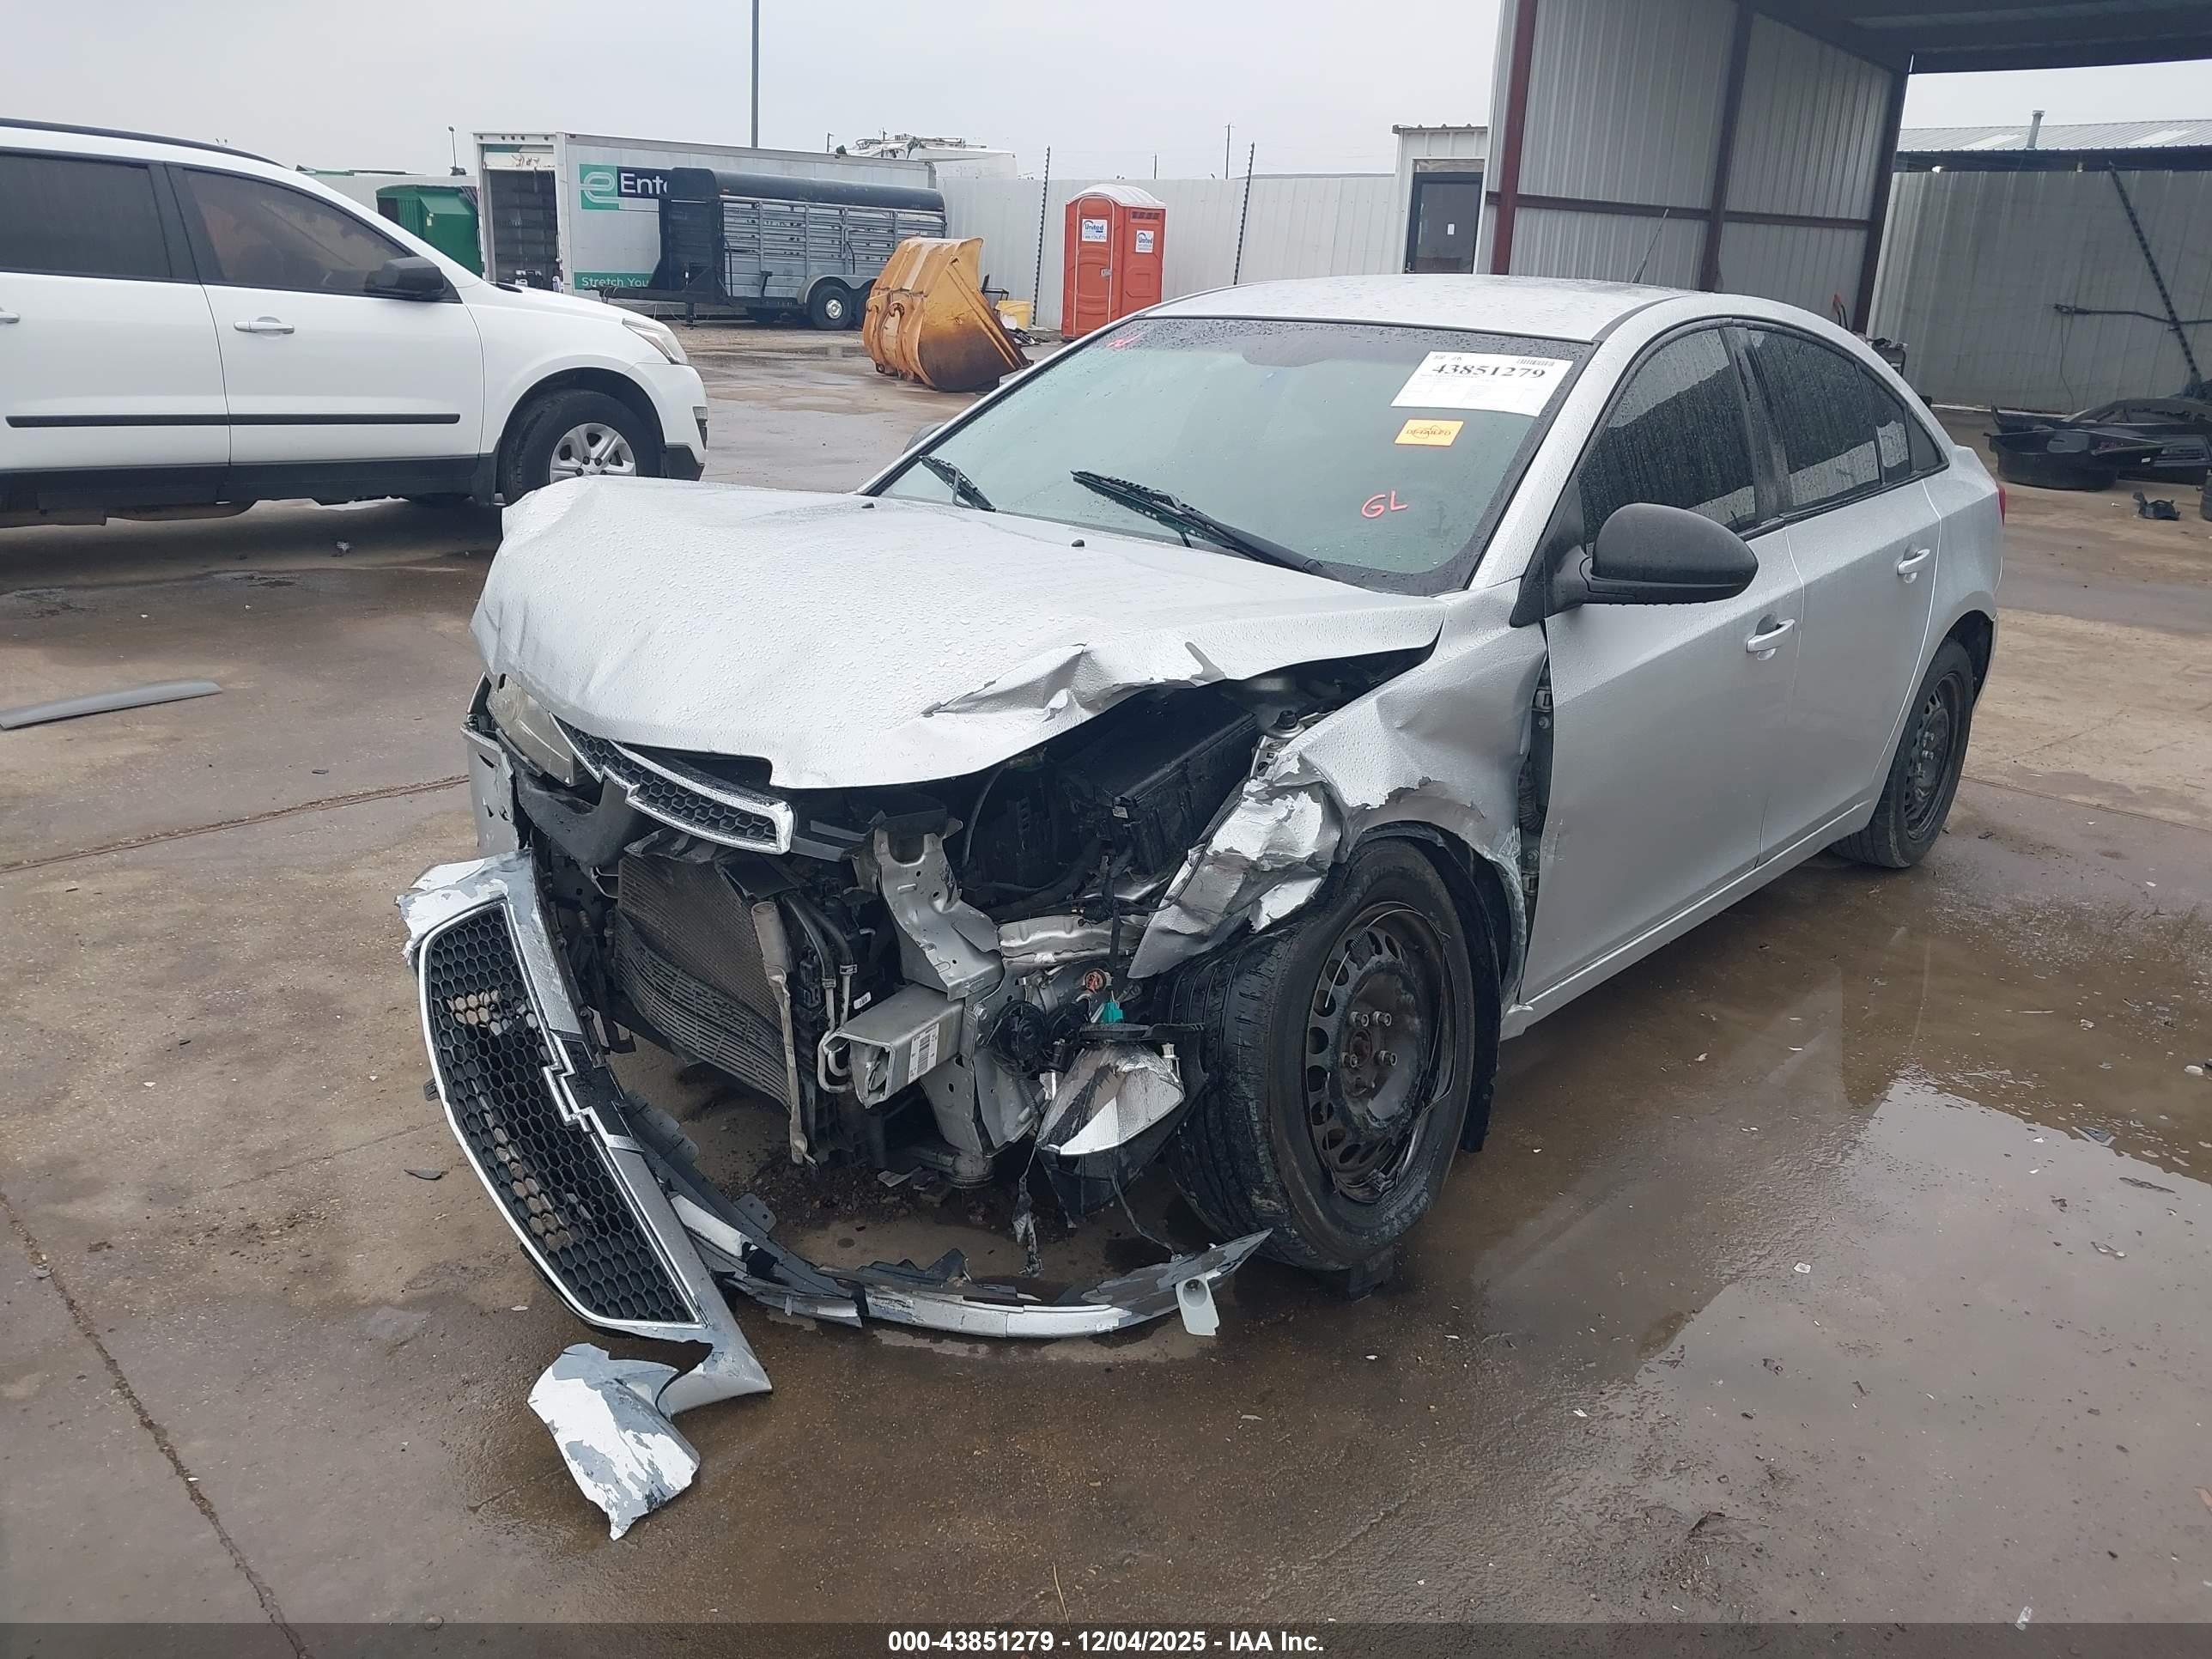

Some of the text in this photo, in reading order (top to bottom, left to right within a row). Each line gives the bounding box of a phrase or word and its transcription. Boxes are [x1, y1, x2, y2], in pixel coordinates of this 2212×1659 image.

[581, 276, 624, 287] Stretch
[1432, 364, 1547, 379] 43851279
[1361, 489, 1408, 518] GL
